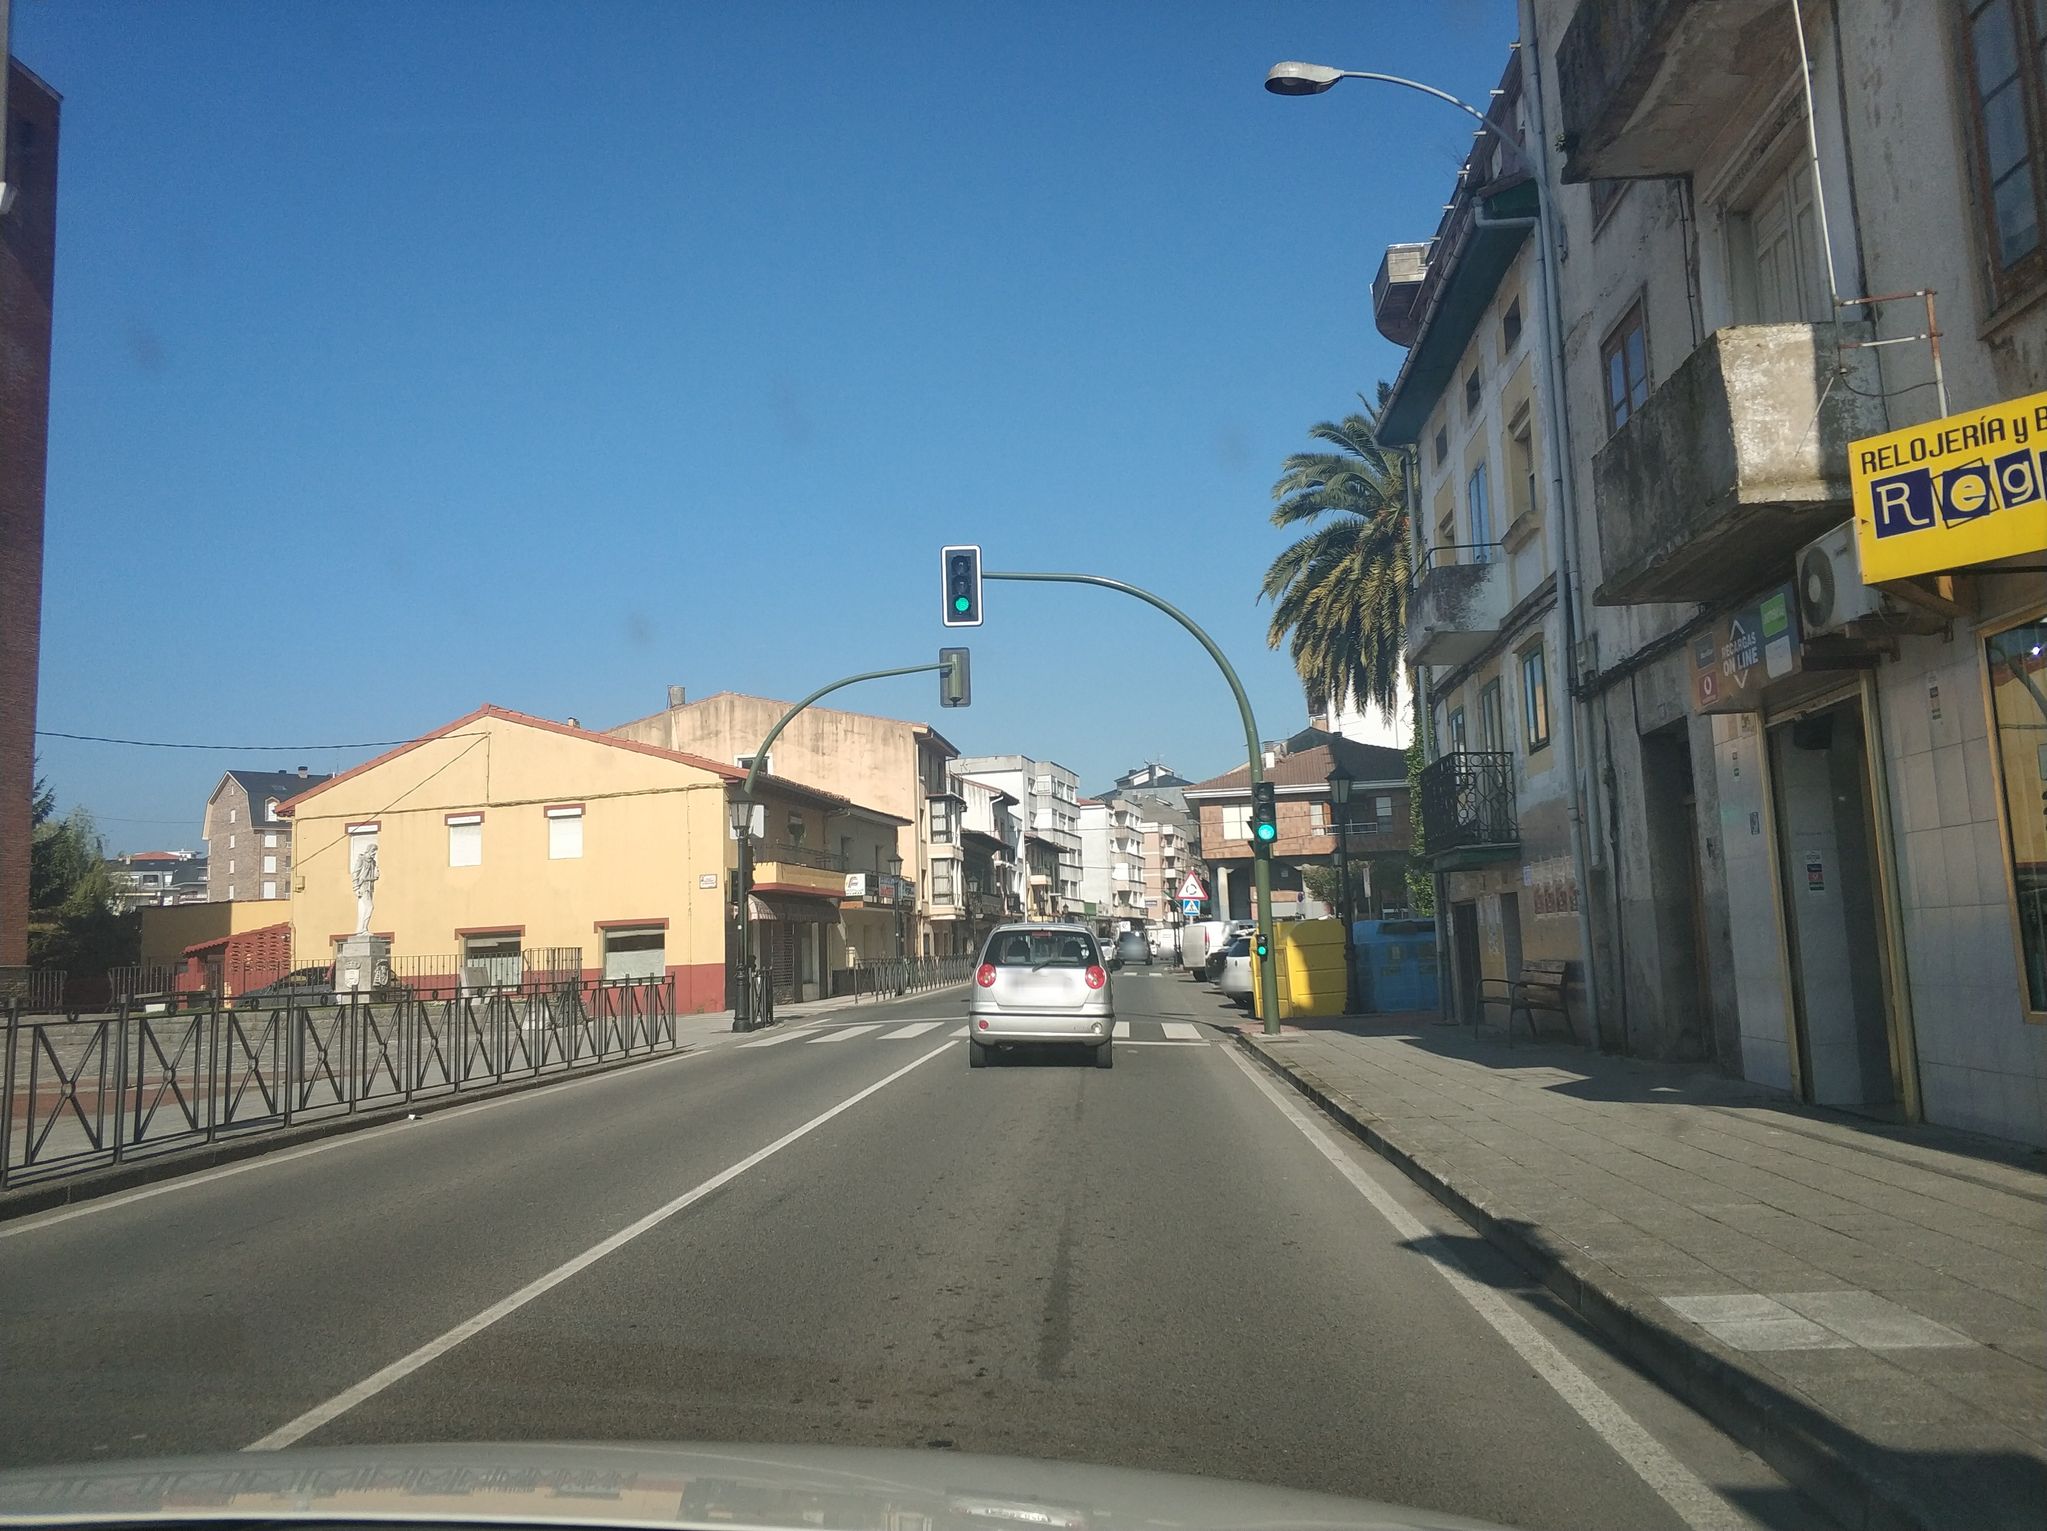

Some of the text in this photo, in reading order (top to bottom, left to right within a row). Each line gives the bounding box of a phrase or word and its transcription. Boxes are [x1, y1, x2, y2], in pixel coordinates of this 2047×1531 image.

[1861, 416, 2006, 475] RELOJERÍA
[2013, 416, 2029, 444] y
[1721, 632, 1757, 659] RECARGAS
[1723, 657, 1736, 677] ON
[1737, 646, 1759, 671] LINE
